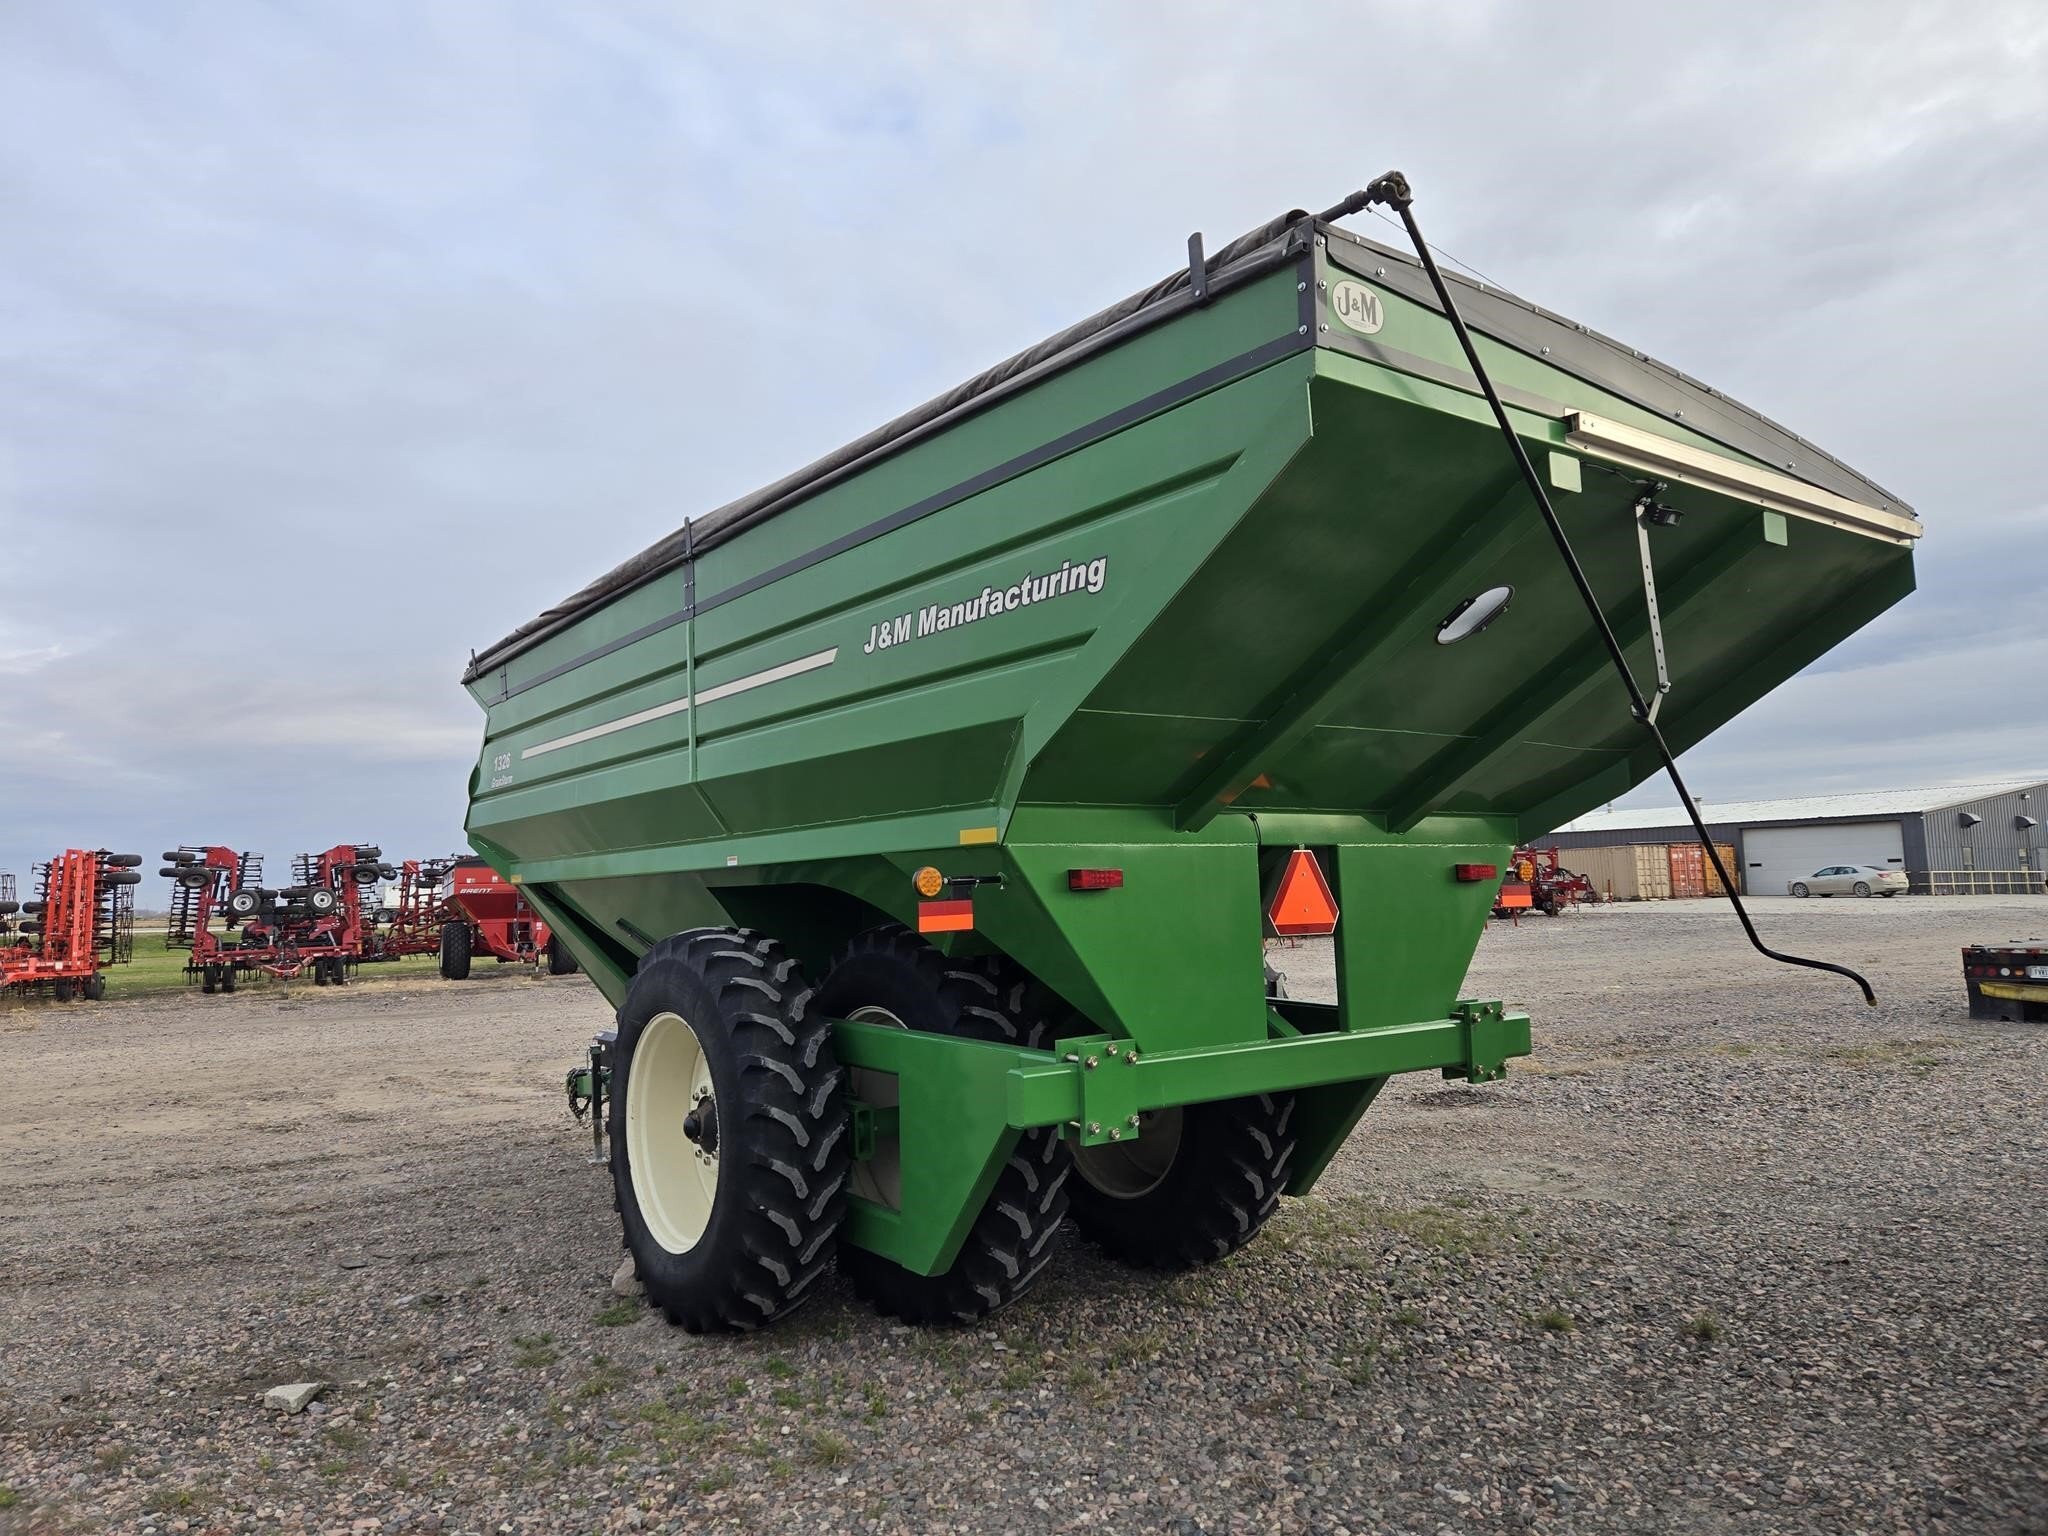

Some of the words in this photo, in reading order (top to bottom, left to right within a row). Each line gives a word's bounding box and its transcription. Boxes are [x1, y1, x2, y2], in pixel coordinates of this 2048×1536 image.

[1336, 286, 1379, 326] J&M
[863, 612, 914, 655] J&M
[916, 555, 1109, 639] Manufacturing
[494, 752, 512, 771] 1326
